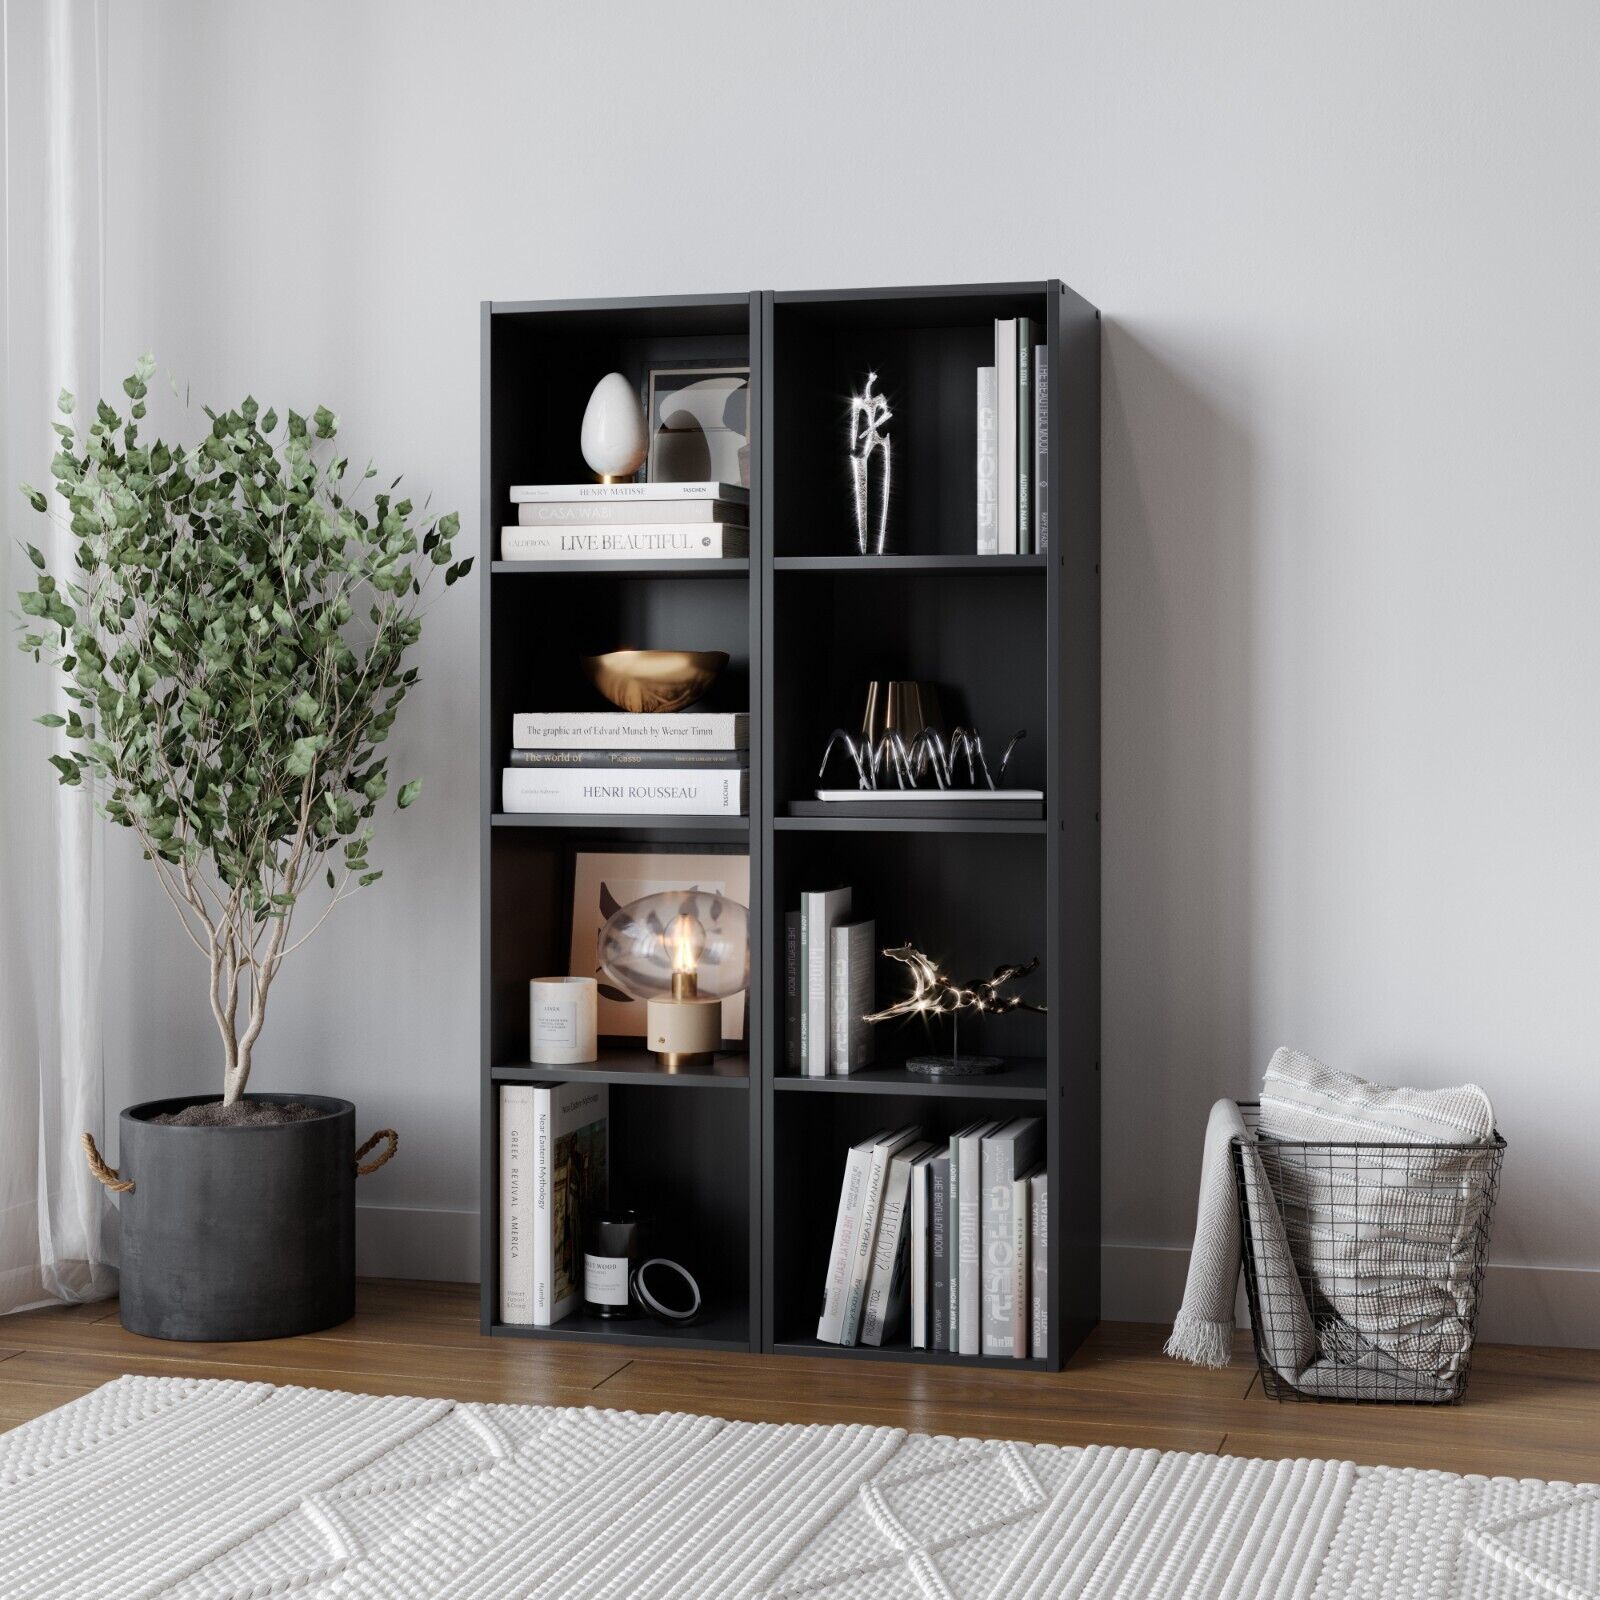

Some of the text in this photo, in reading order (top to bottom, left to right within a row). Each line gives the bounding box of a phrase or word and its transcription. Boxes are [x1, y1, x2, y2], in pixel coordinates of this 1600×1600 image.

[1039, 428, 1048, 455] MOON
[578, 487, 646, 496] HENRY MATISSE
[538, 507, 577, 520] CASA
[560, 534, 694, 551] LIVE BEAUTIFUL
[527, 726, 542, 735] The
[543, 726, 570, 737] graphic
[571, 727, 582, 735] art
[583, 726, 592, 735] of
[593, 726, 620, 735] Edvard
[622, 726, 648, 735] Munch
[650, 726, 659, 737] by
[661, 726, 689, 736] Werner
[524, 752, 583, 762] The world of
[609, 755, 642, 763] Picasso
[583, 786, 698, 799] HENRI ROUSSEAU
[536, 1113, 547, 1210] Near Eastern Mythology
[511, 1130, 519, 1259] GREEK REVIVAL AMERICA
